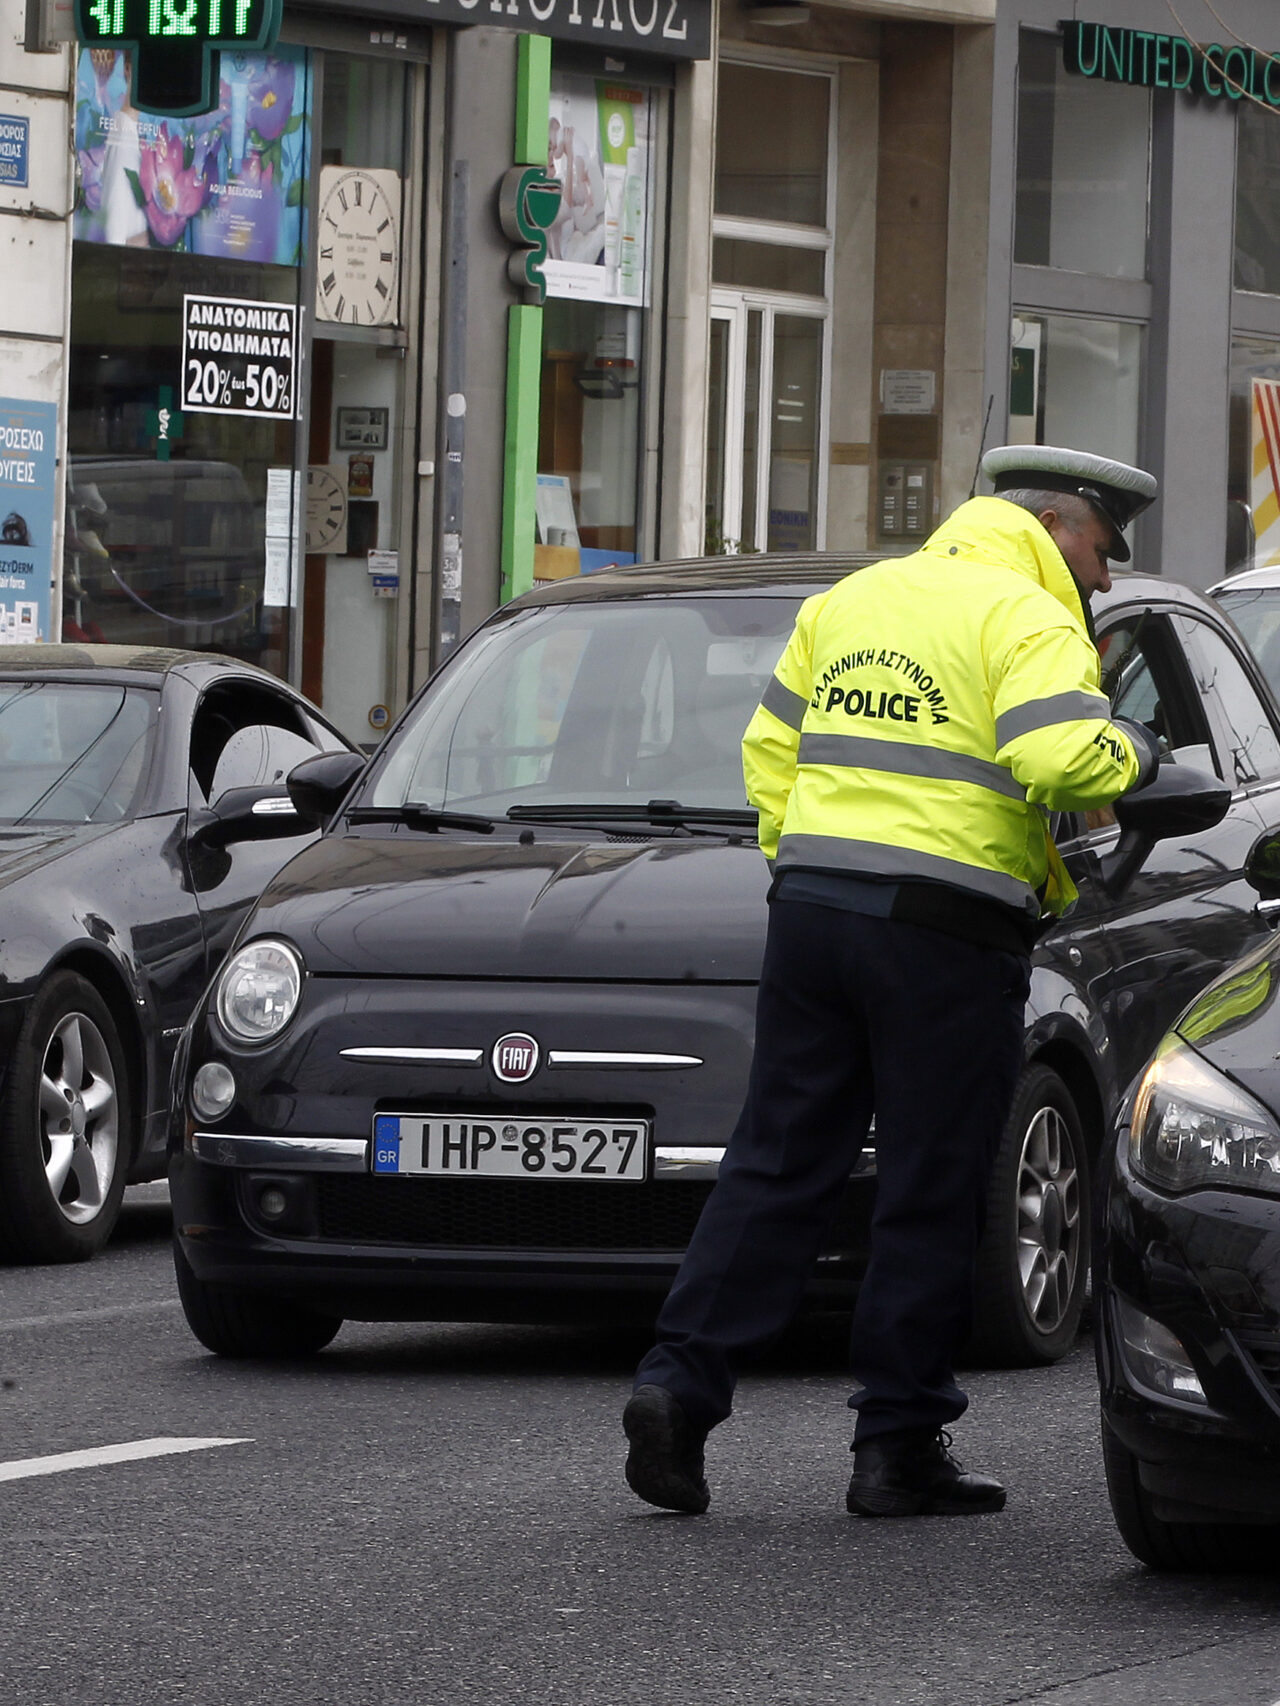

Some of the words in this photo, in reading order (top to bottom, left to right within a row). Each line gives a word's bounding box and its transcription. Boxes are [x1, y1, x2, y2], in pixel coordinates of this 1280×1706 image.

[1078, 22, 1193, 89] UNITED
[190, 304, 290, 332] ΑΝΑΤΟΜΙΚΑ
[187, 329, 291, 358] ΥΠΟΔΗΜΑΤΑ
[187, 359, 231, 405] 20%
[245, 364, 289, 410] 50%
[811, 649, 875, 709] ΕΛΛΗΝΙΚΗ
[876, 649, 950, 725] ΑΣΤΥΝΟΜΙΑ
[825, 687, 922, 723] POLICE
[502, 1046, 531, 1071] FIAT
[377, 1151, 396, 1164] GR
